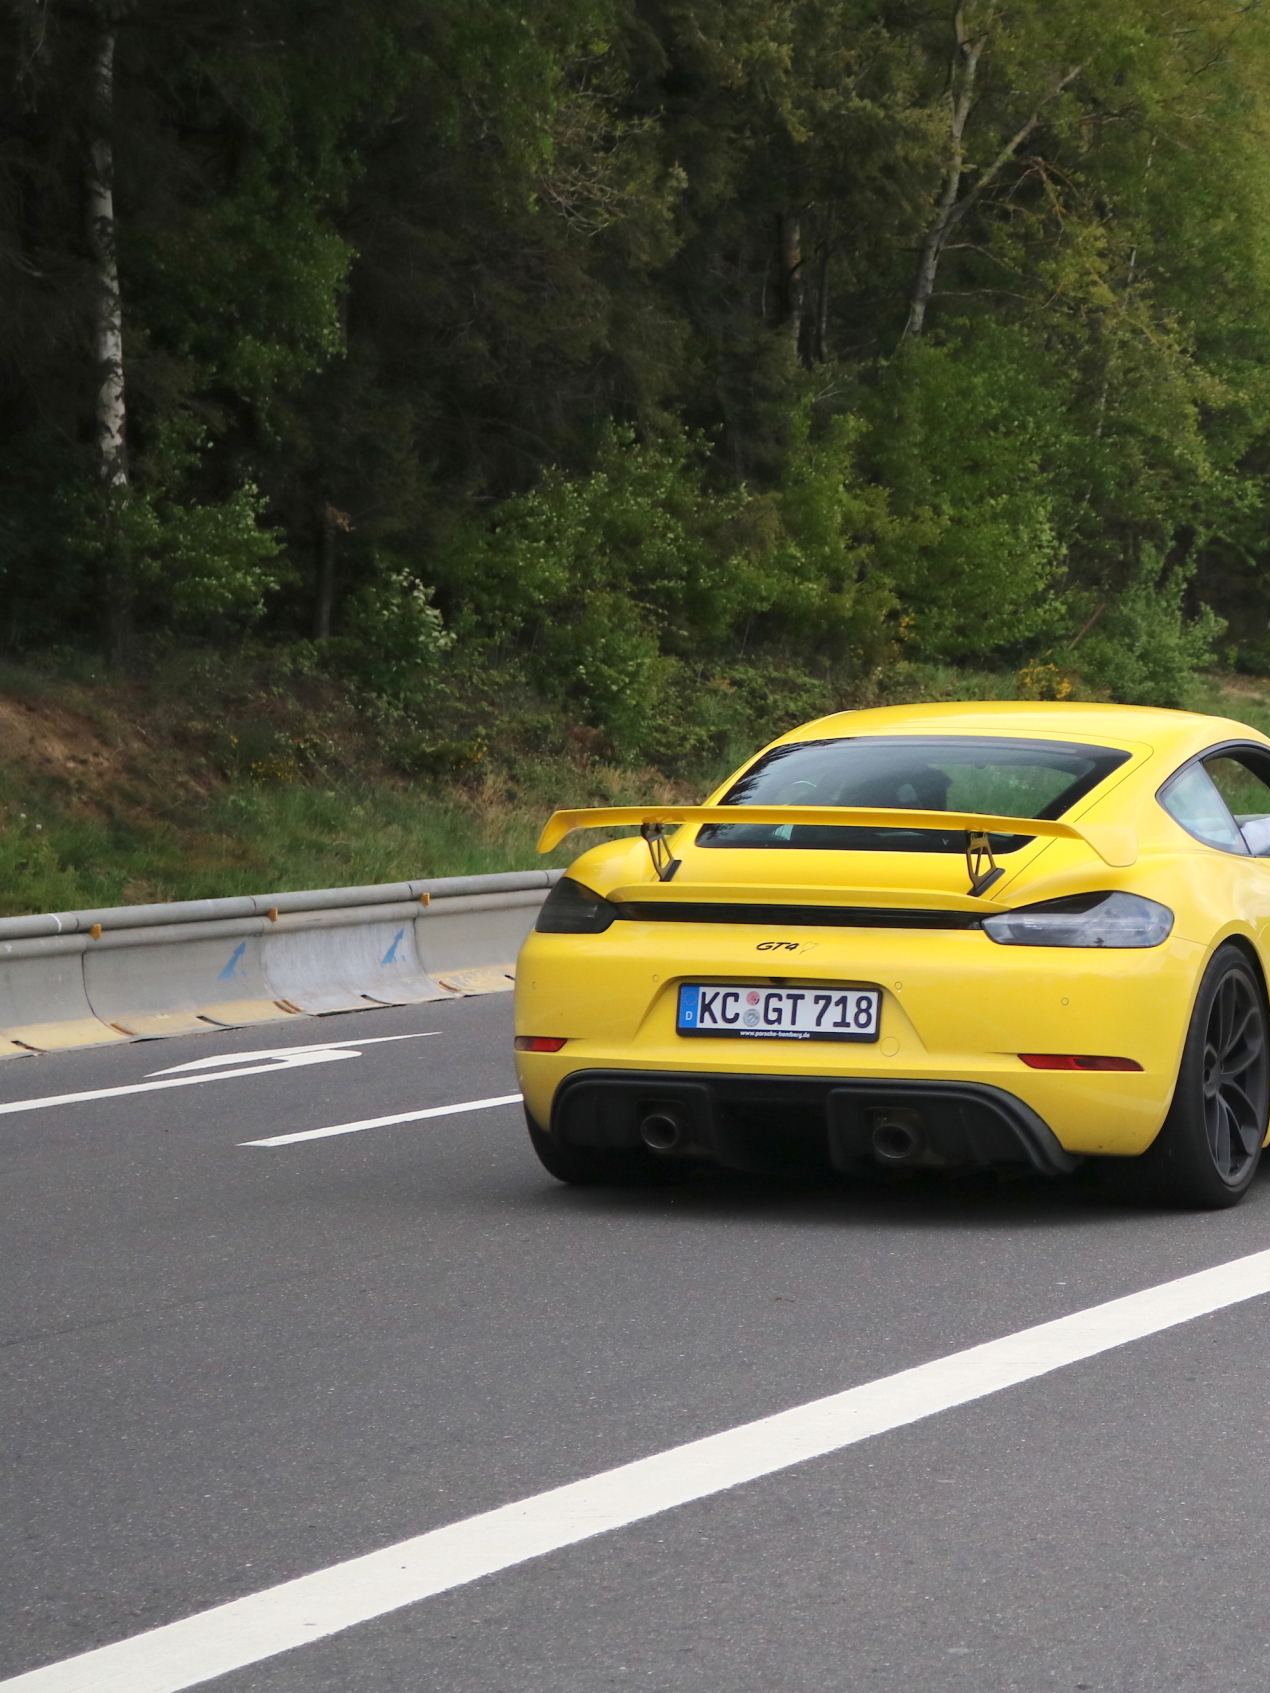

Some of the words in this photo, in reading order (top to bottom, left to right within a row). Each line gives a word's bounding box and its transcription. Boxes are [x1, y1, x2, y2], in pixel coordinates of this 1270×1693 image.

[756, 942, 799, 951] GT4
[699, 991, 740, 1024] KC
[763, 993, 805, 1026] GT
[813, 994, 873, 1029] 718
[685, 1011, 693, 1021] D
